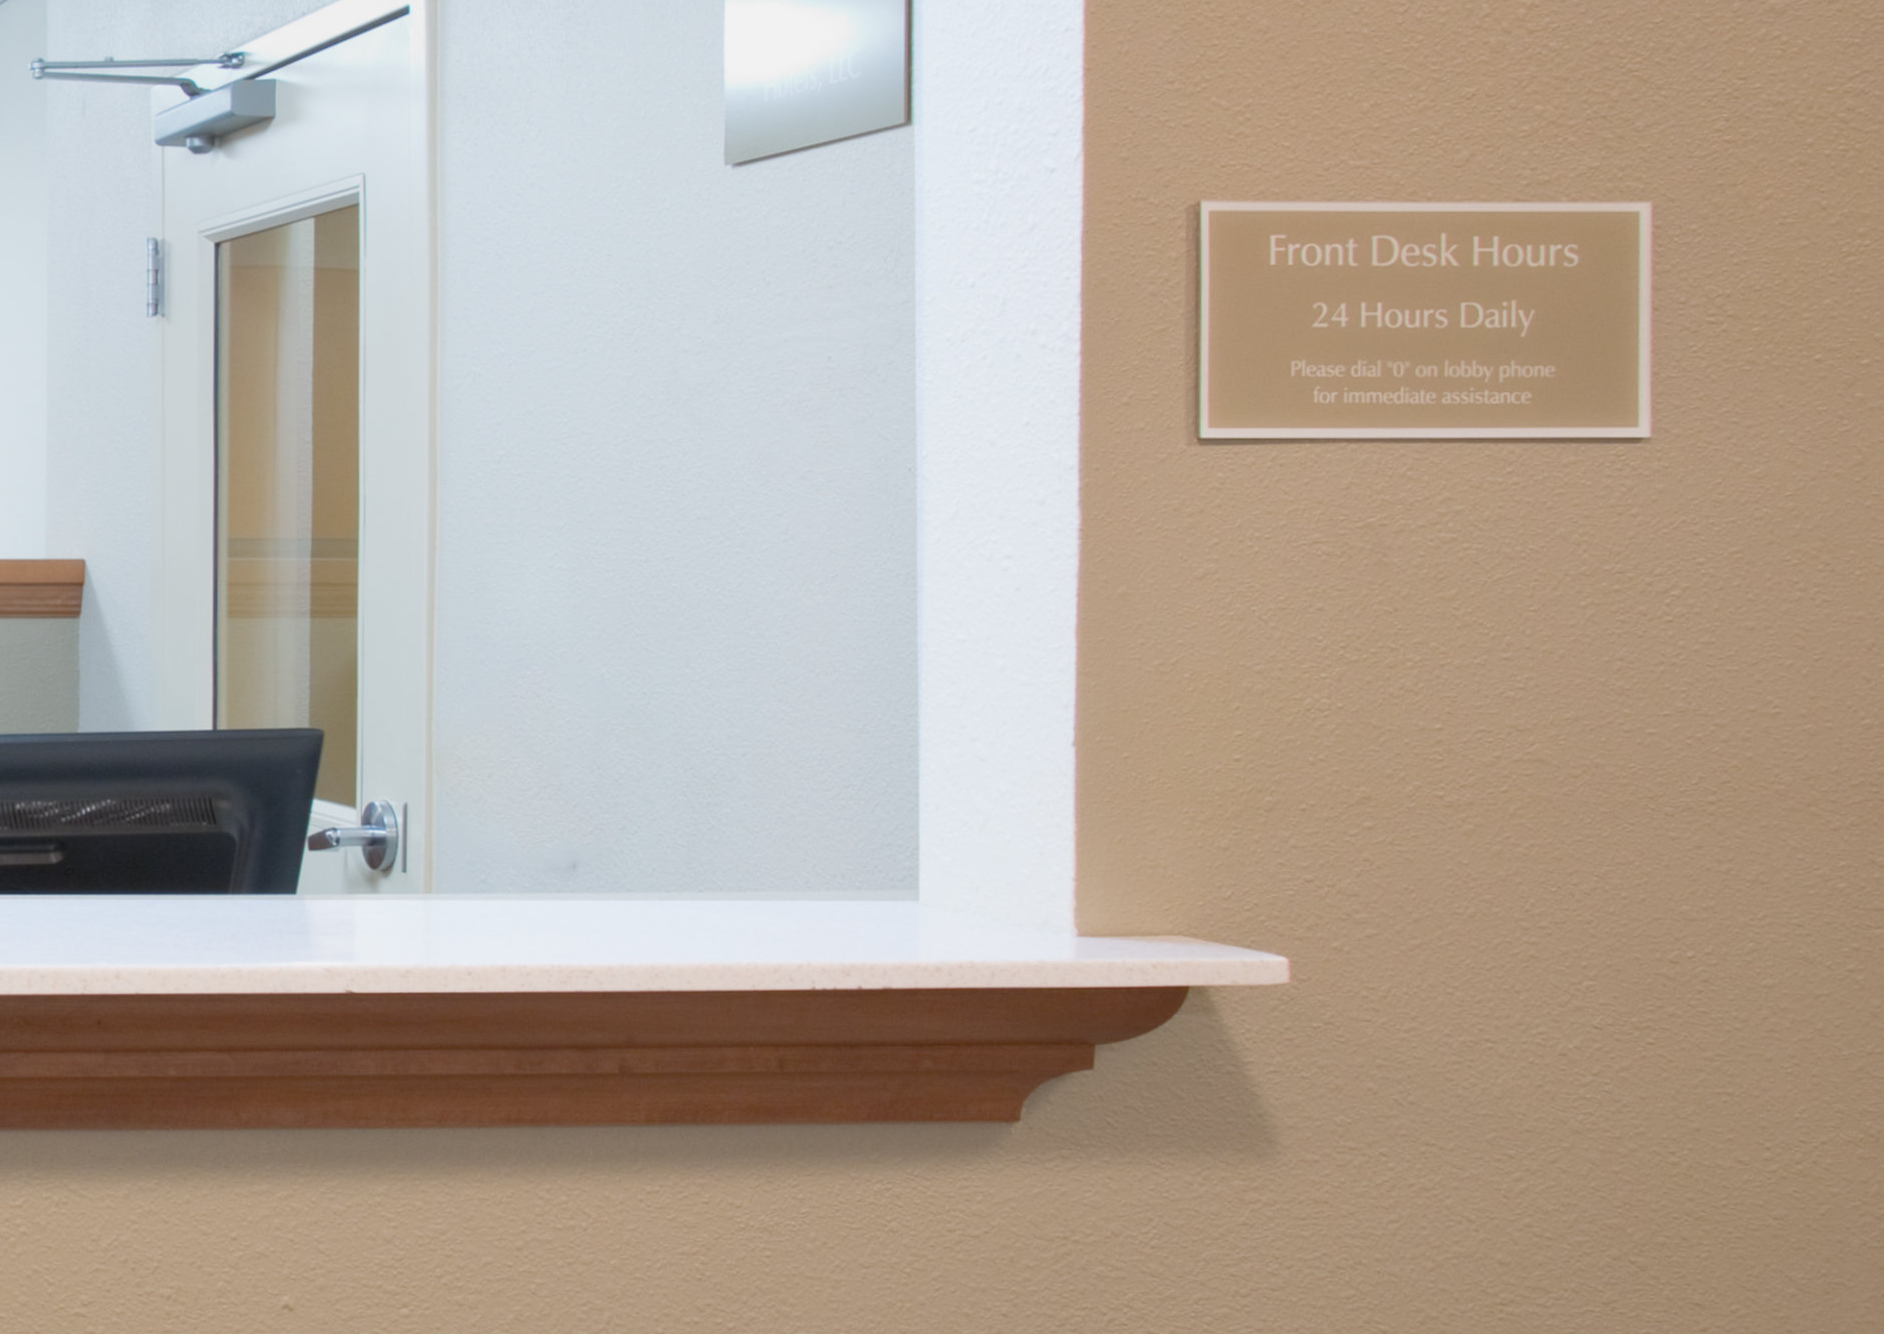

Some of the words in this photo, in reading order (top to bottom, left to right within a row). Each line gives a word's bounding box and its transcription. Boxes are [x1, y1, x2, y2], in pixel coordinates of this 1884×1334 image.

[829, 49, 864, 83] LLC
[1268, 234, 1358, 267] Front
[1371, 232, 1460, 267] Desk
[1472, 235, 1579, 267] Hours
[1312, 302, 1349, 328] 24
[1360, 302, 1449, 328] Hours
[1459, 300, 1535, 337] Daily
[1290, 360, 1345, 378] Please
[1351, 359, 1382, 378] dial
[1387, 360, 1411, 378] "0"
[1415, 364, 1438, 378] on
[1444, 359, 1494, 383] lobby
[1499, 359, 1556, 383] phone
[1313, 386, 1338, 404] for
[1343, 387, 1437, 404] immediate
[1441, 387, 1532, 404] assistance
